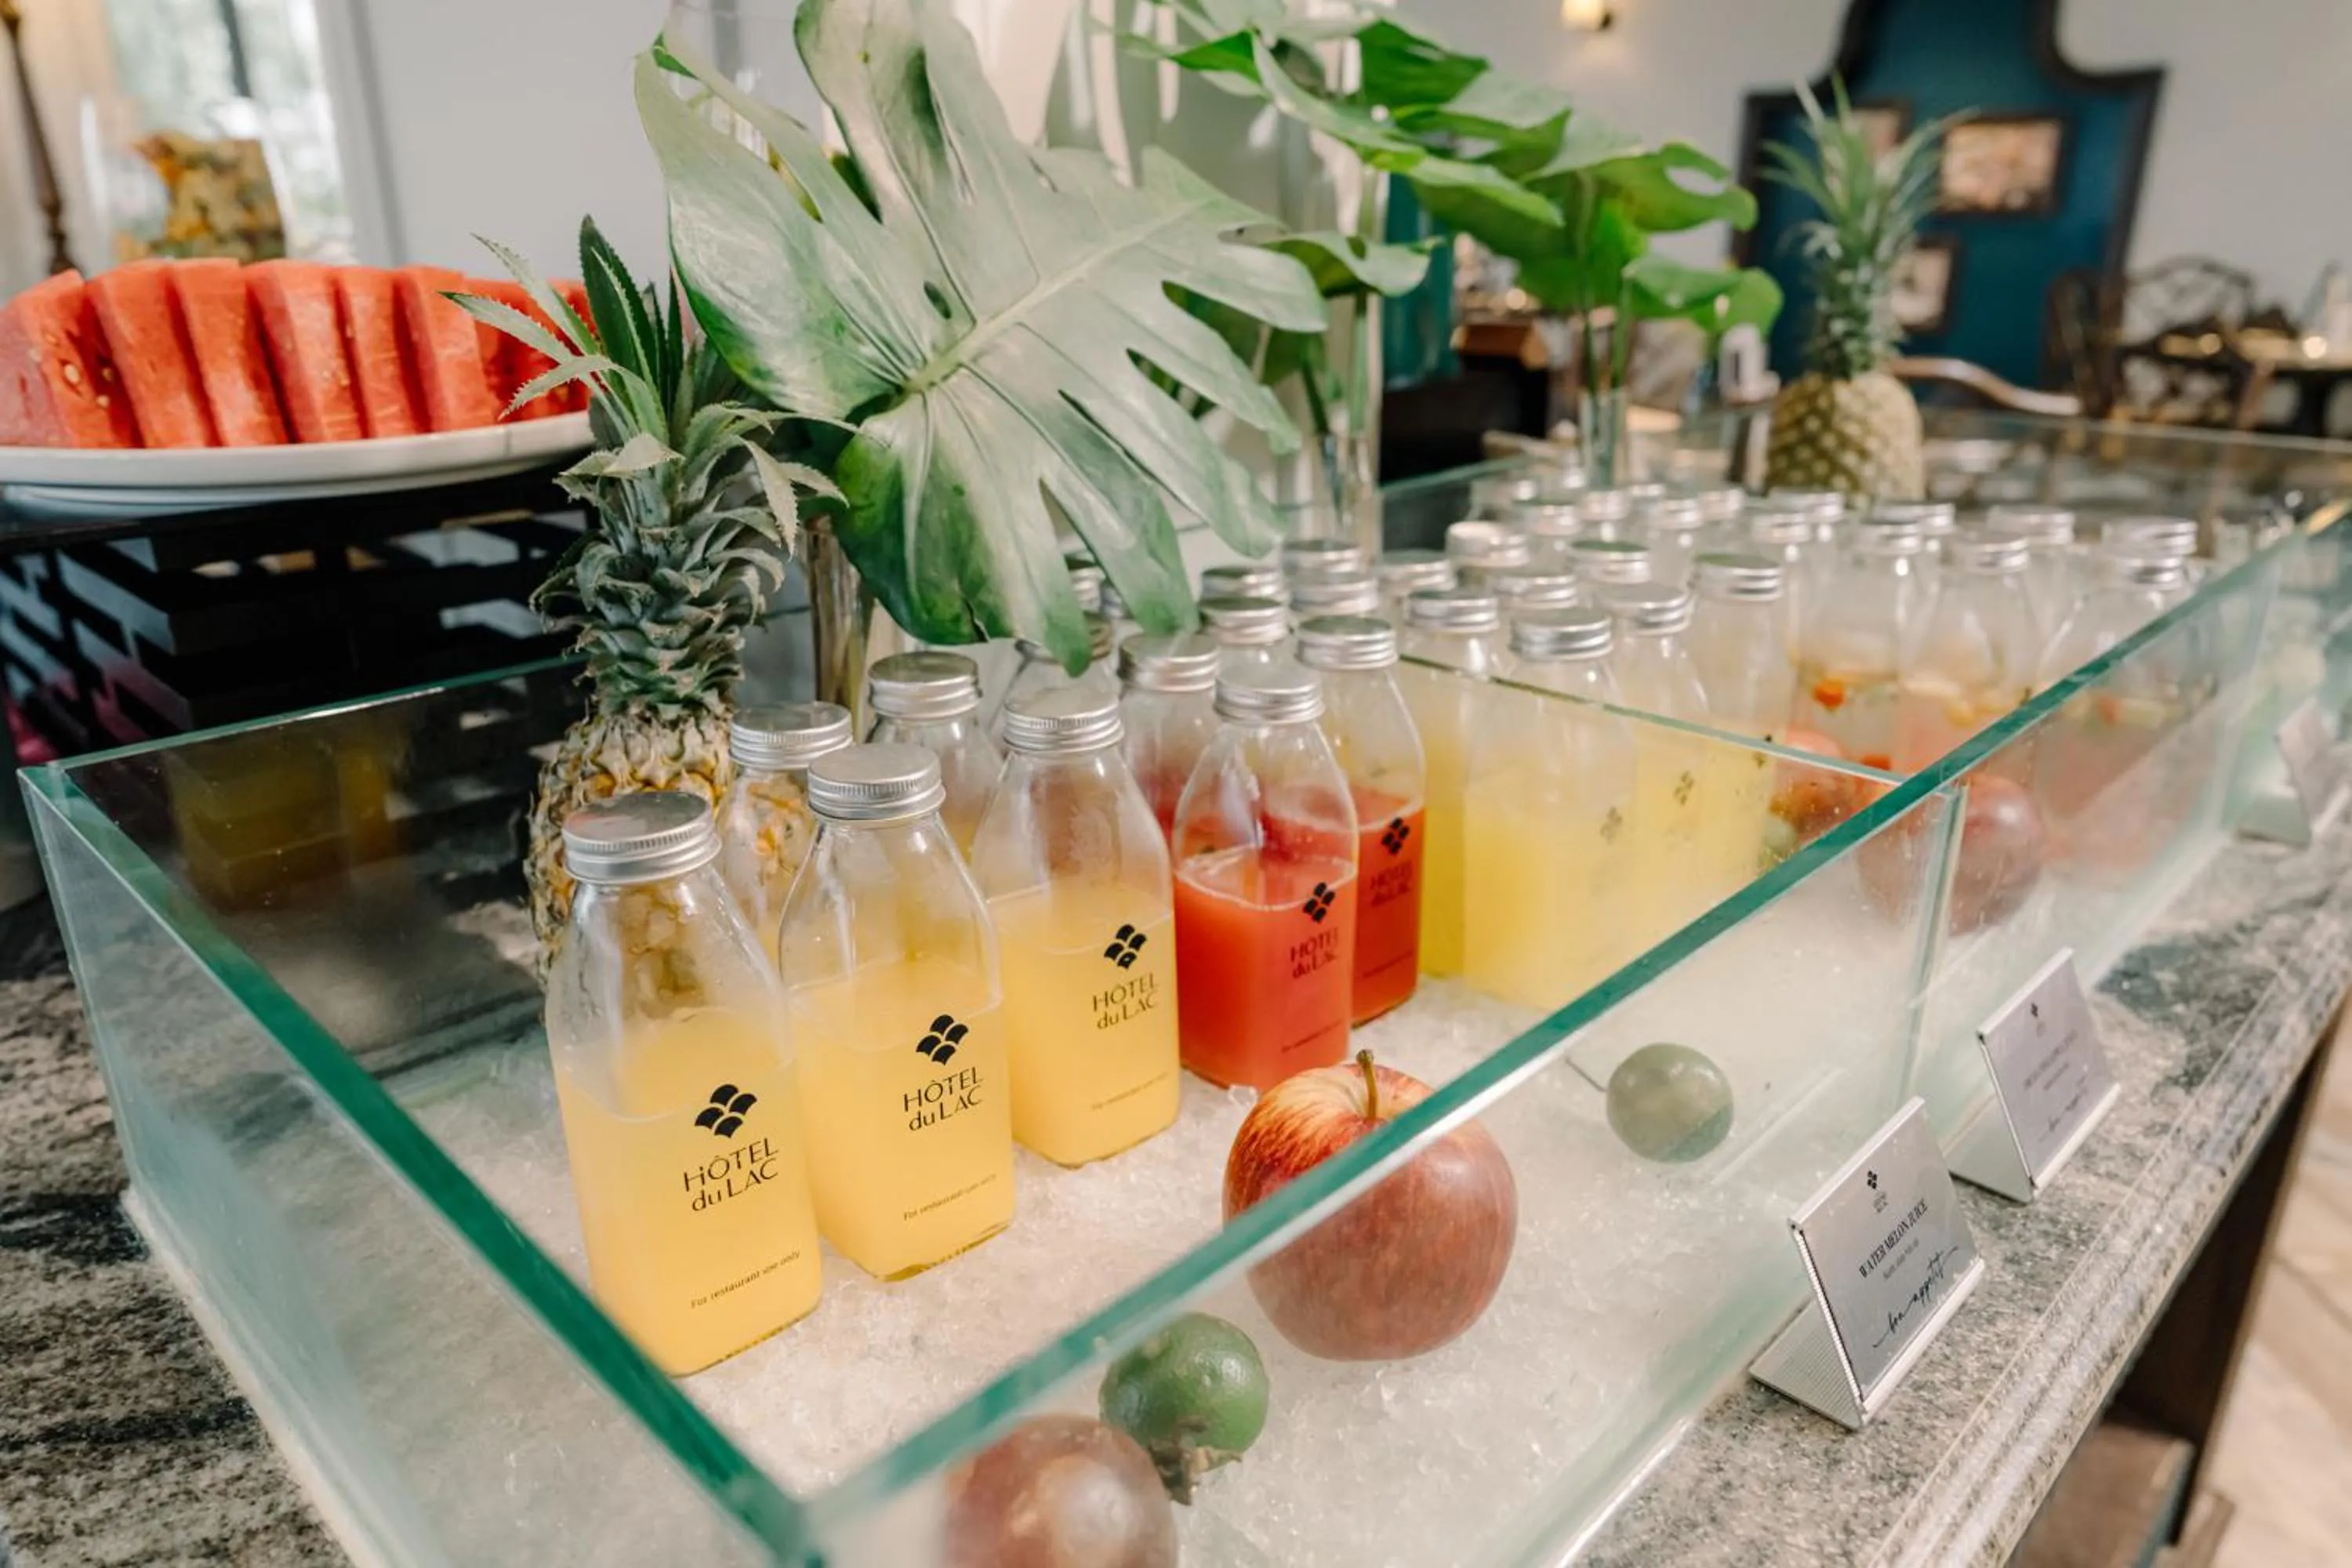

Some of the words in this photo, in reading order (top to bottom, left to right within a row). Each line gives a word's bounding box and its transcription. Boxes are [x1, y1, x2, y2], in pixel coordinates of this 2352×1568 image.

[1097, 1011, 1120, 1029] du
[1123, 989, 1159, 1021] LAC
[909, 1110, 936, 1131] du
[939, 1084, 983, 1120] LAC
[683, 1138, 779, 1192] HÔTEL
[691, 1189, 722, 1211] du
[726, 1157, 779, 1198] LAC
